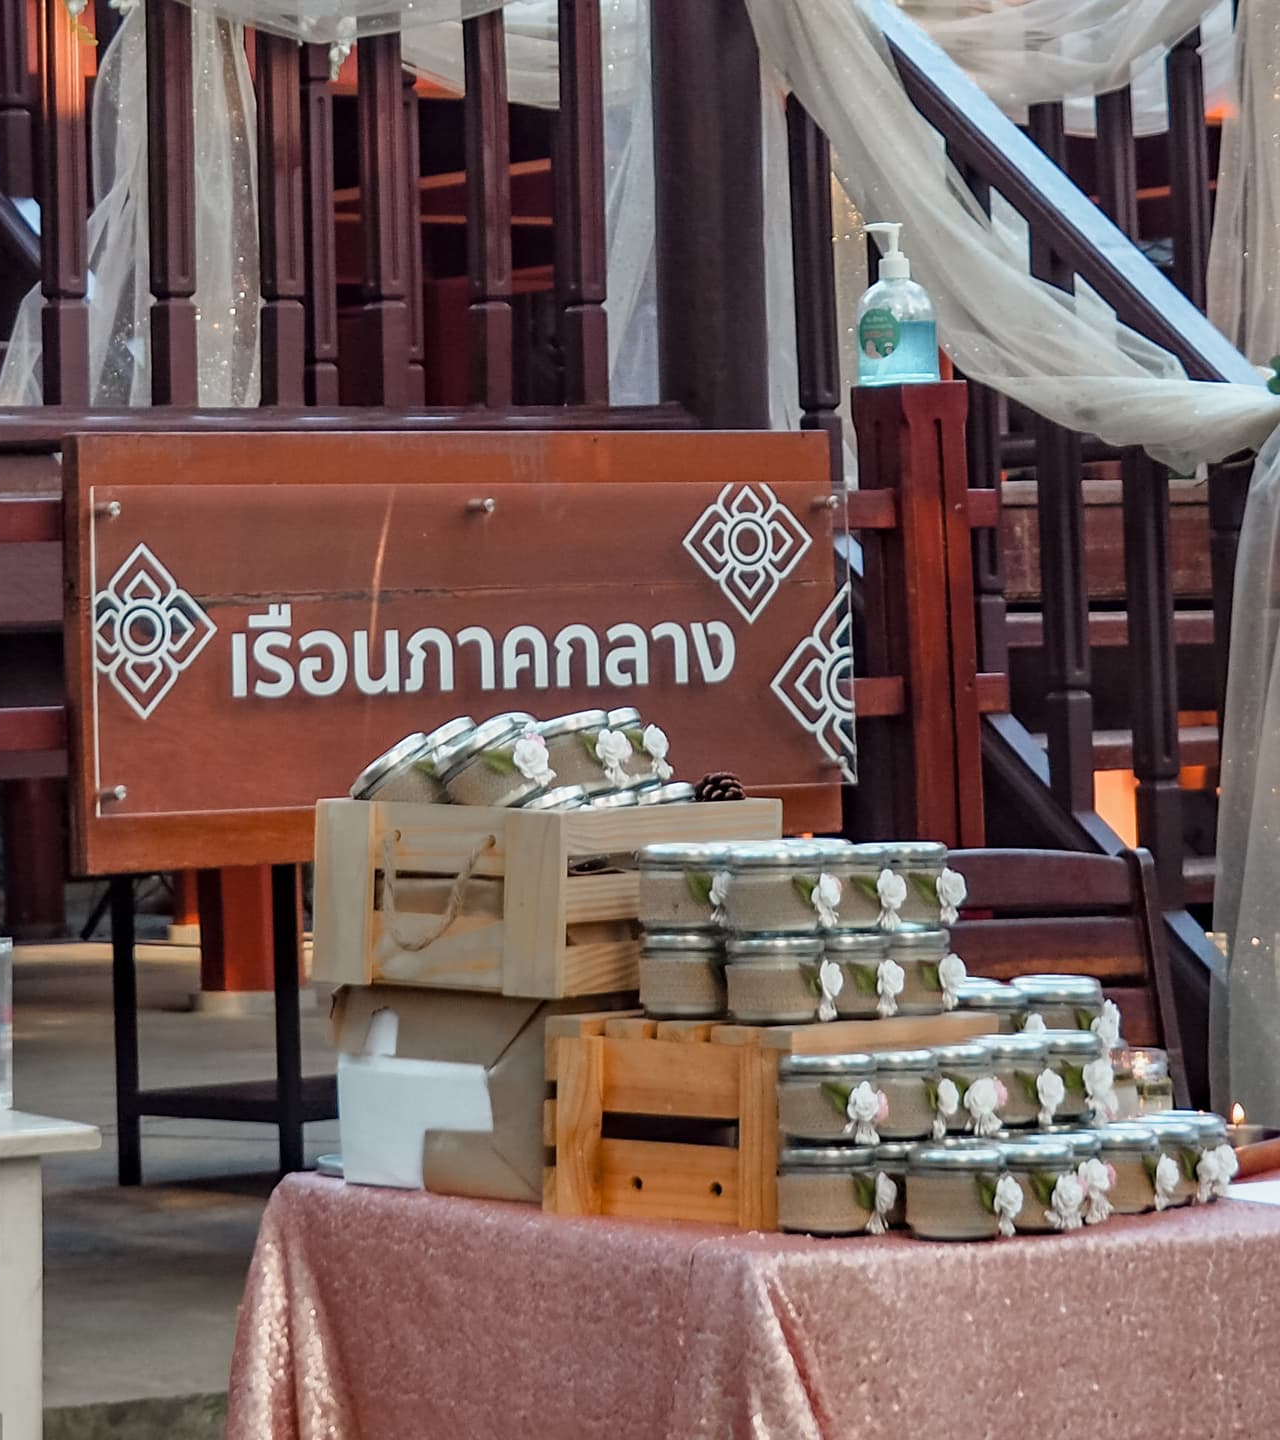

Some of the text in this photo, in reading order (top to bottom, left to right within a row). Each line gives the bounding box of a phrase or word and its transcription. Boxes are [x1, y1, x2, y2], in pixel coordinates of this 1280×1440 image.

[231, 603, 737, 699] เรือนภาคกลาง
